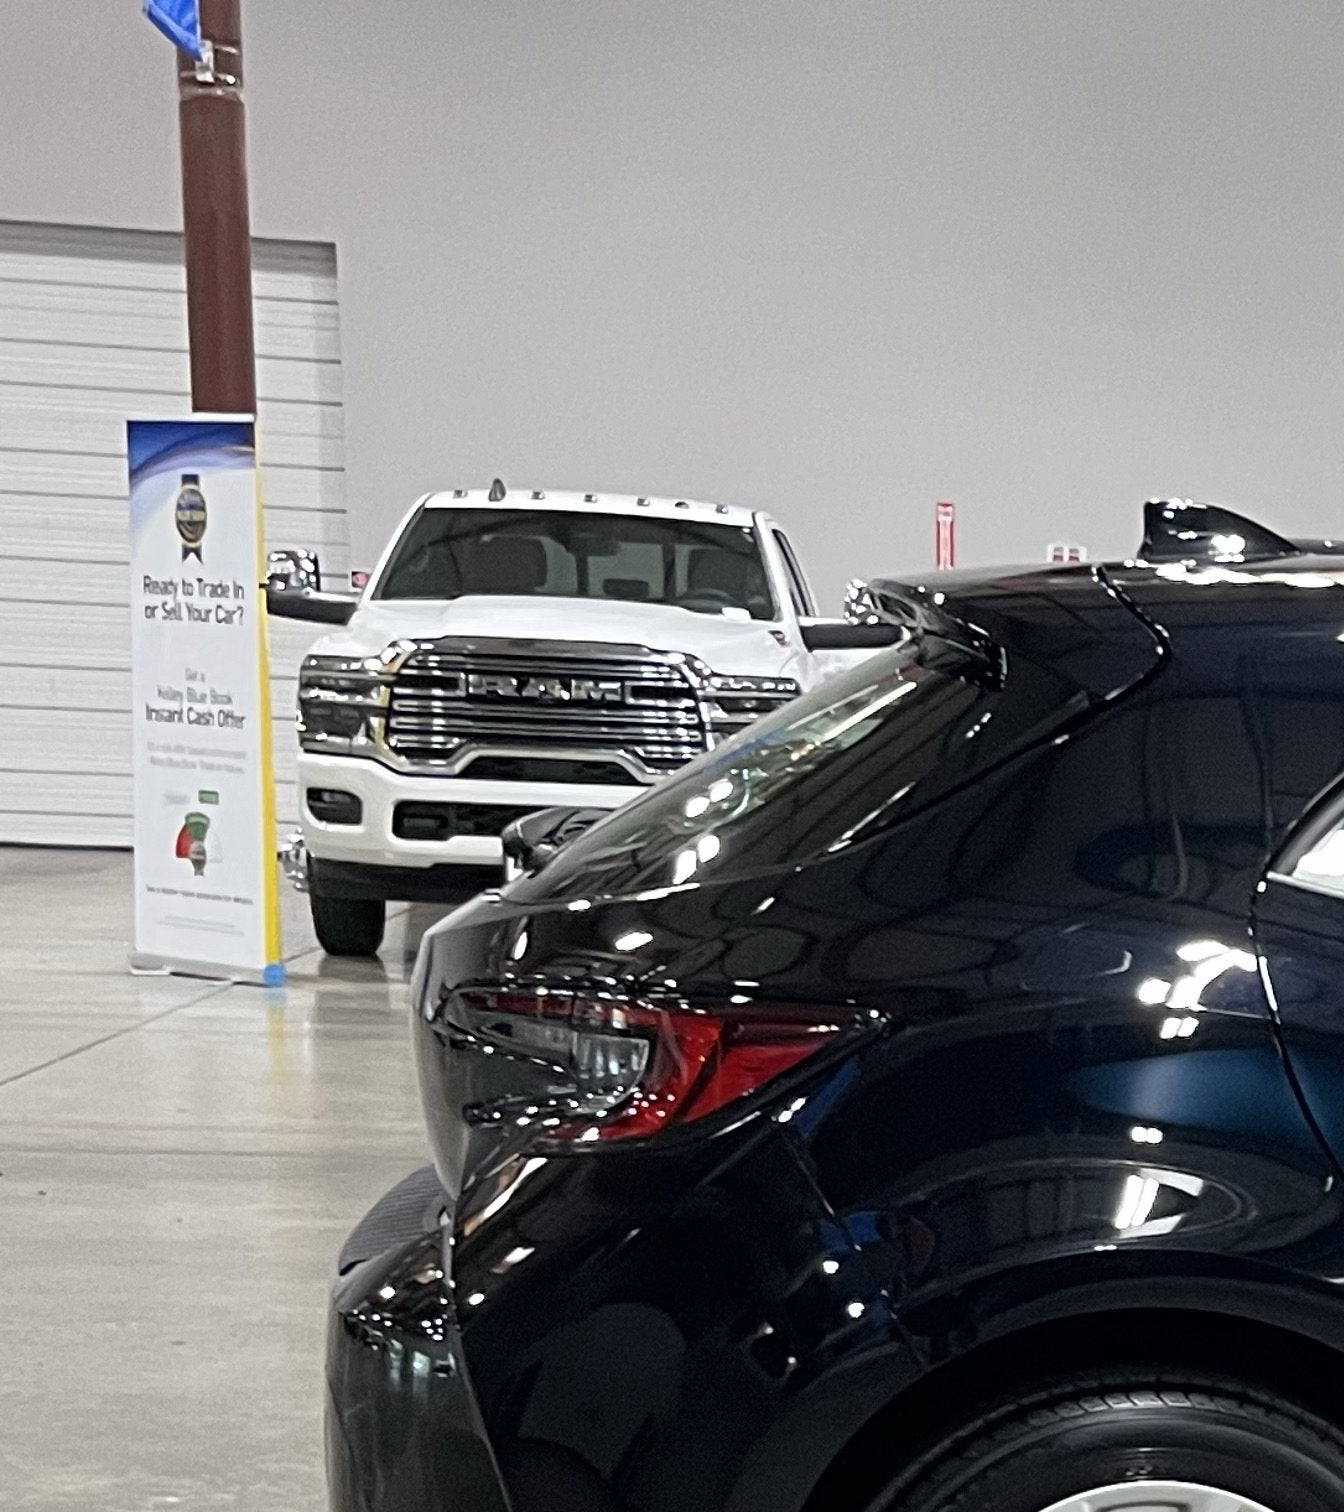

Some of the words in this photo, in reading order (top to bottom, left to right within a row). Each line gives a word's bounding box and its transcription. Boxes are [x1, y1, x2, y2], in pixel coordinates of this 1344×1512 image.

[143, 575, 178, 602] Ready
[181, 578, 194, 596] to
[196, 578, 230, 599] Trade
[233, 580, 245, 600] In
[144, 605, 158, 619] or
[161, 601, 182, 621] Sell
[185, 602, 213, 623] Your
[215, 604, 244, 625] Car?
[467, 674, 622, 701] RAM
[187, 706, 215, 726] Cash
